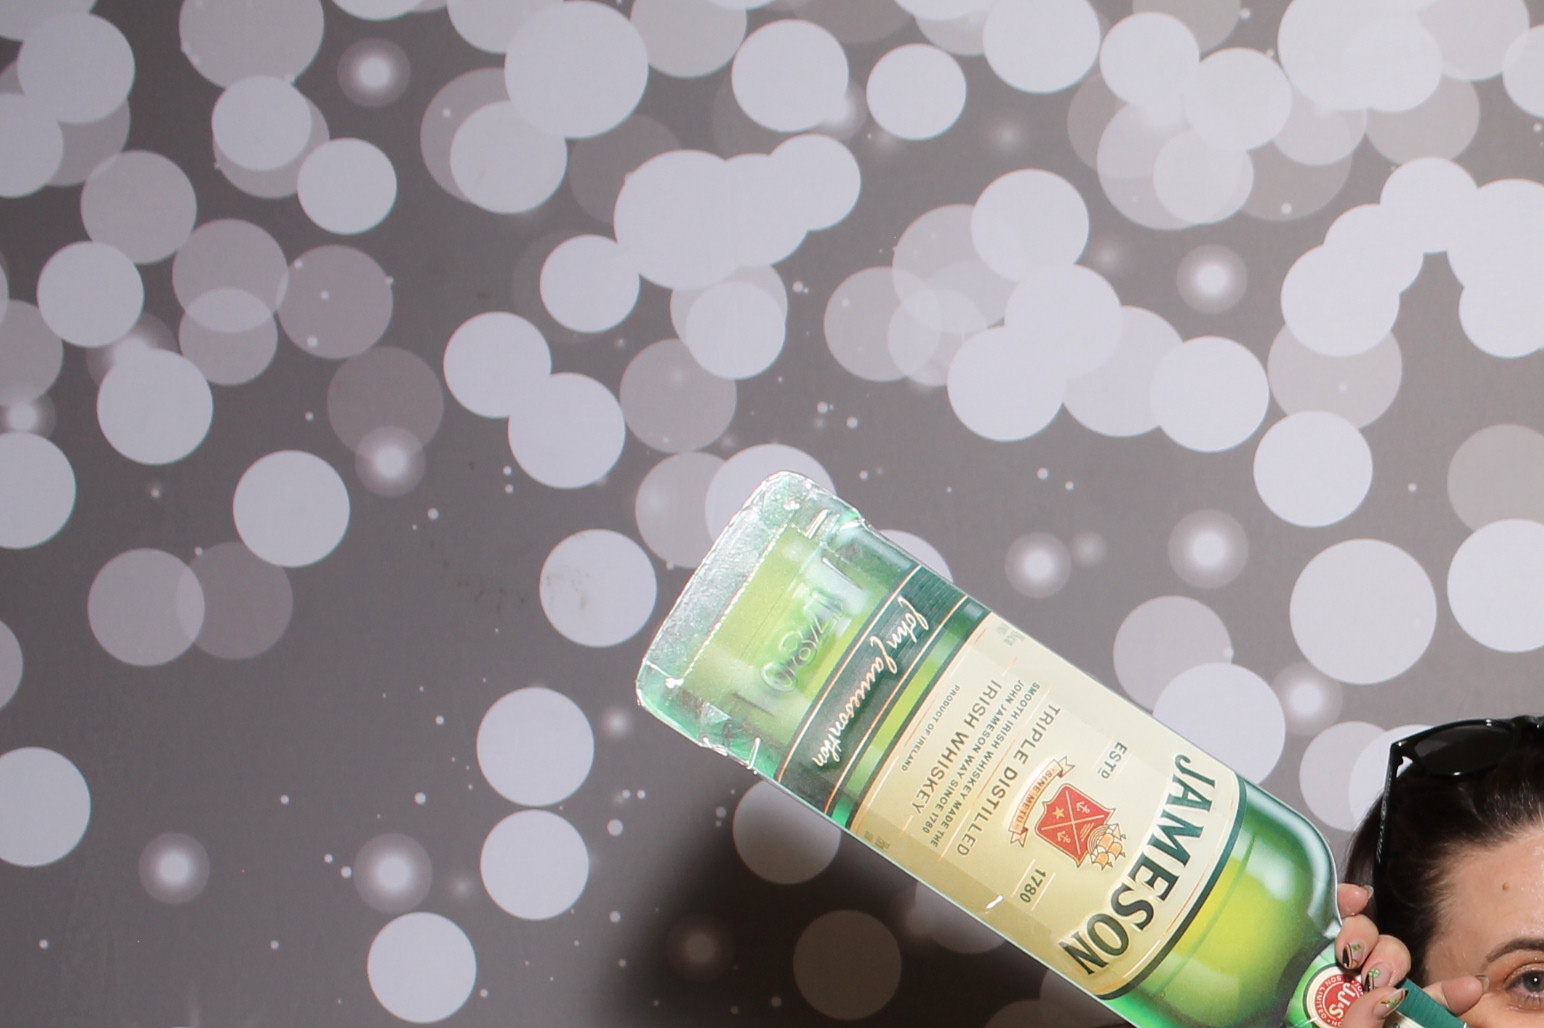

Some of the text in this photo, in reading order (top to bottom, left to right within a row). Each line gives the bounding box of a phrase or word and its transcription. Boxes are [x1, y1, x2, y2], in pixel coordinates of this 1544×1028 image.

[902, 685, 960, 771] PRODUCT OF IRELAND
[912, 680, 1001, 813] IRISH WHISKEY
[923, 680, 1024, 833] JOHN JAMESON WAY SINCE 1780
[931, 682, 1040, 847] SMOOTH IRISH WHISKEY MADE THE
[957, 705, 1060, 855] TRIPLE DISTILLED
[1012, 767, 1053, 824] SINE METU
[1020, 869, 1046, 903] 1780
[1059, 755, 1216, 975] JAMESON
